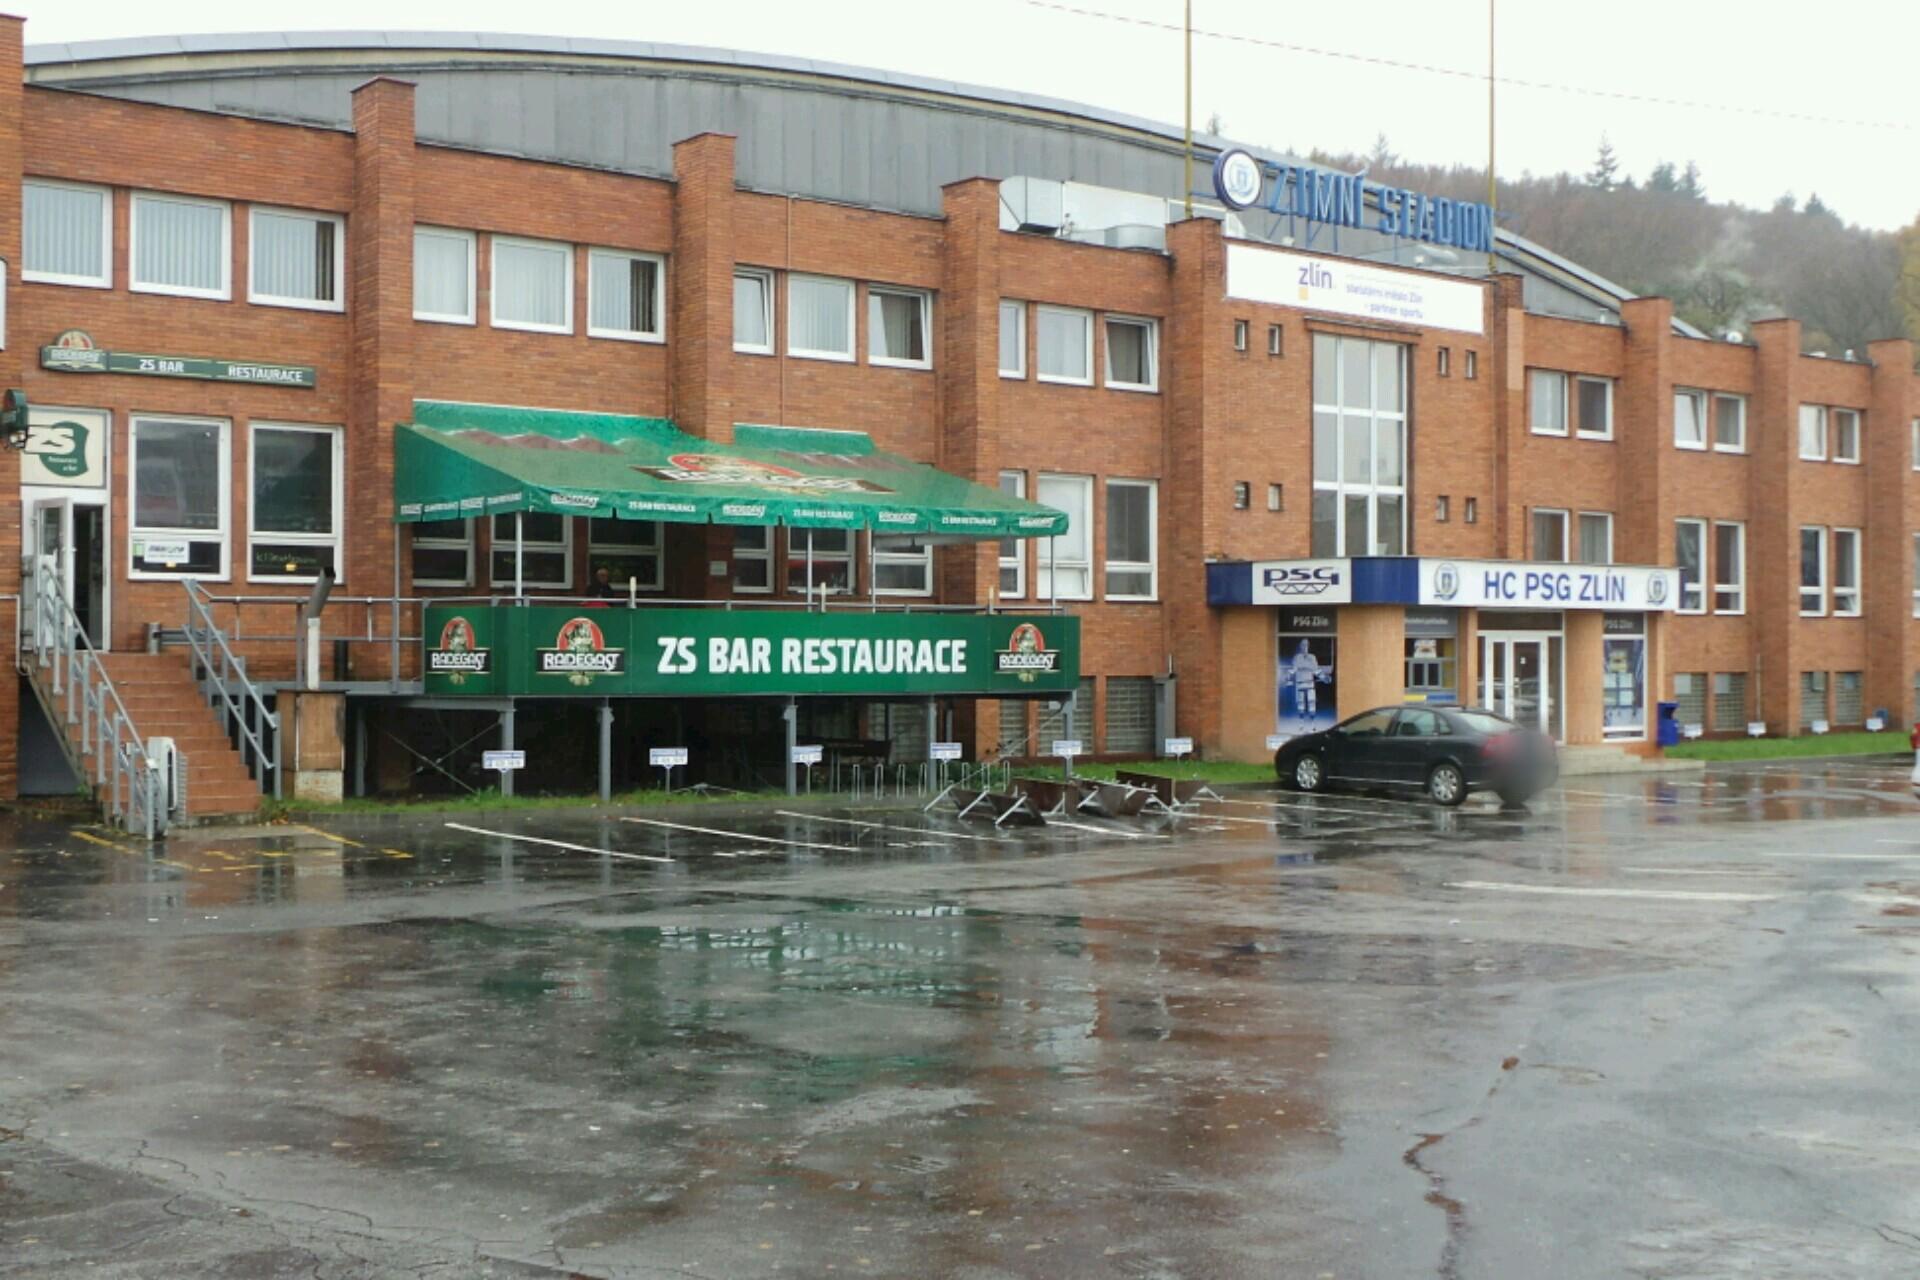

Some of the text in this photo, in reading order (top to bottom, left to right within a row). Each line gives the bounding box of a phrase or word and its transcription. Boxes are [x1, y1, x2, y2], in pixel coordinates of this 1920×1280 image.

[1264, 160, 1495, 253] ZIMNÍ STADION
[139, 359, 184, 373] ZS BAR
[228, 365, 303, 382] RESTAURACE
[1484, 570, 1625, 601] HC PSG ZLÍN
[1293, 615, 1310, 627] PSG
[431, 652, 487, 671] RADEGAST
[543, 652, 620, 671] RADEGAST
[657, 637, 968, 675] ZS BAR RESTAURACE
